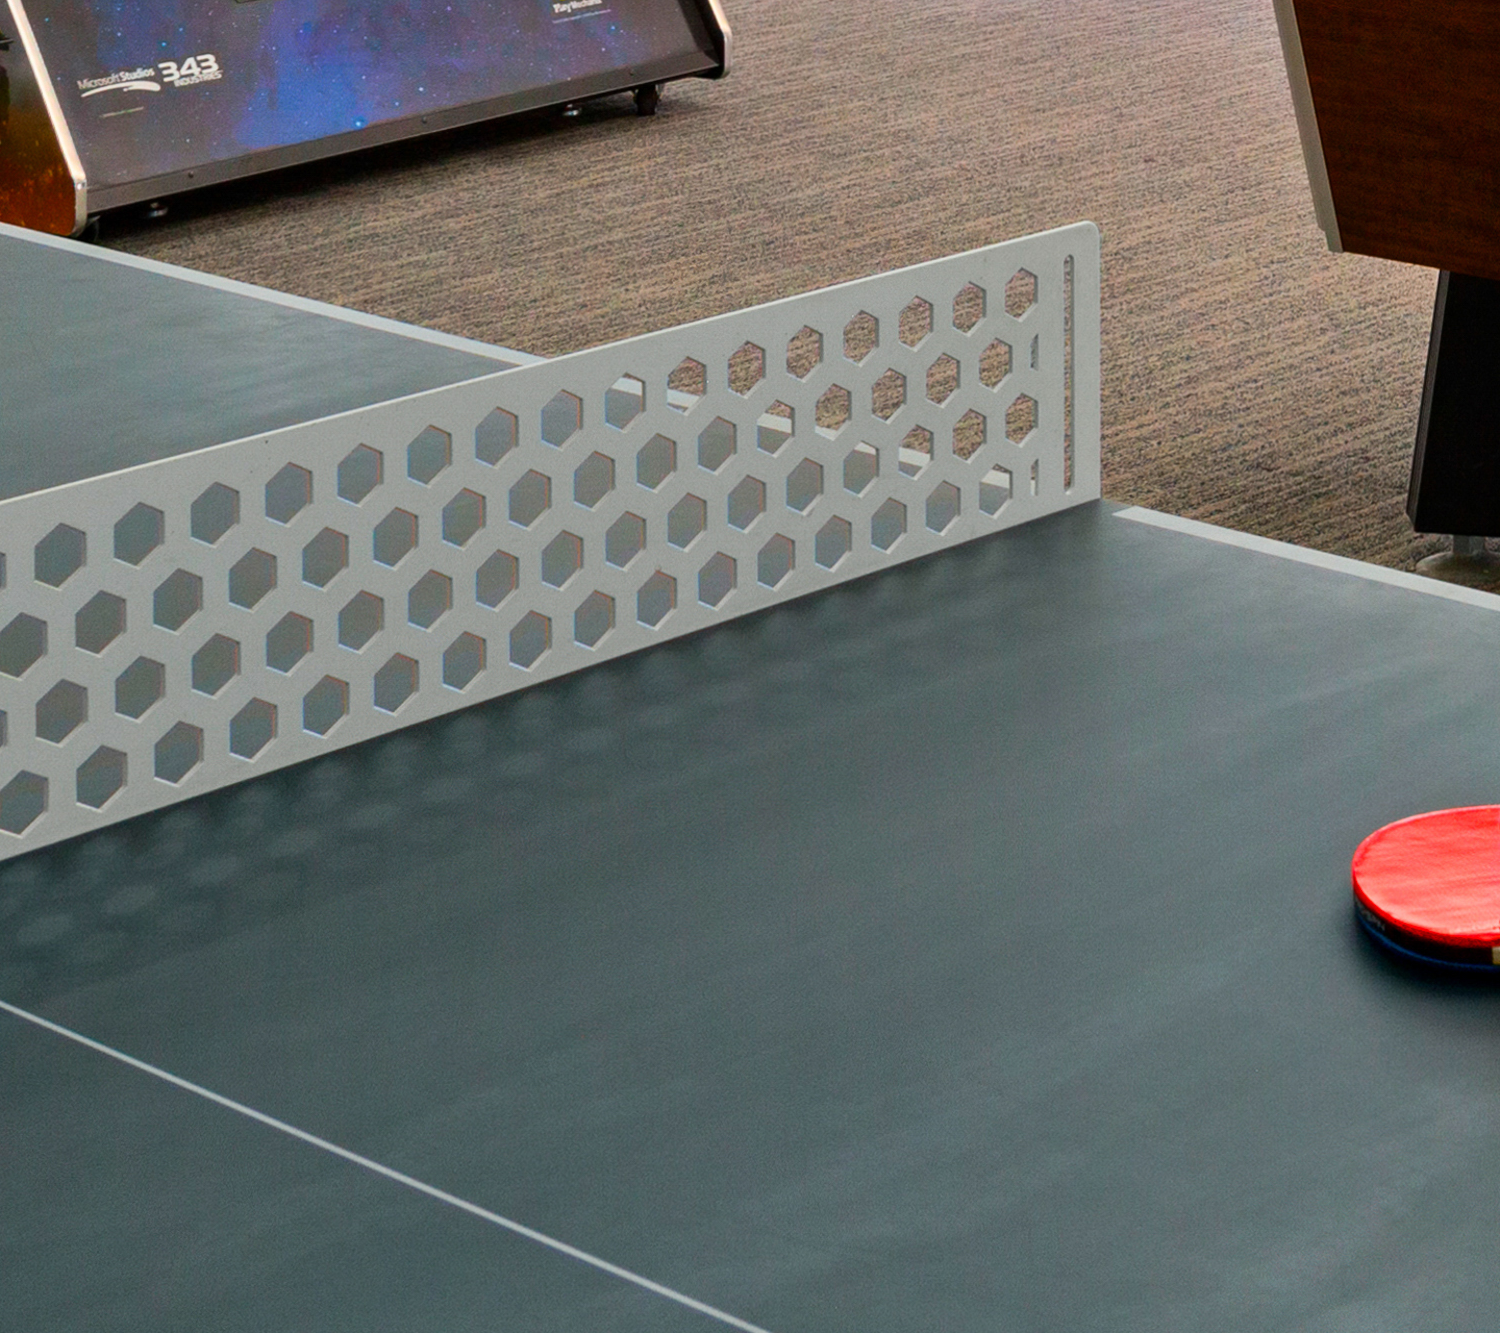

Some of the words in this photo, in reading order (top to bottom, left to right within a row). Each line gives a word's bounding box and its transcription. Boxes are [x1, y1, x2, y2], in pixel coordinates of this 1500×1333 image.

[77, 72, 120, 90] Microsoft
[120, 67, 155, 82] Studios
[158, 53, 219, 82] 343
[173, 70, 223, 87] INDUSTRIES
